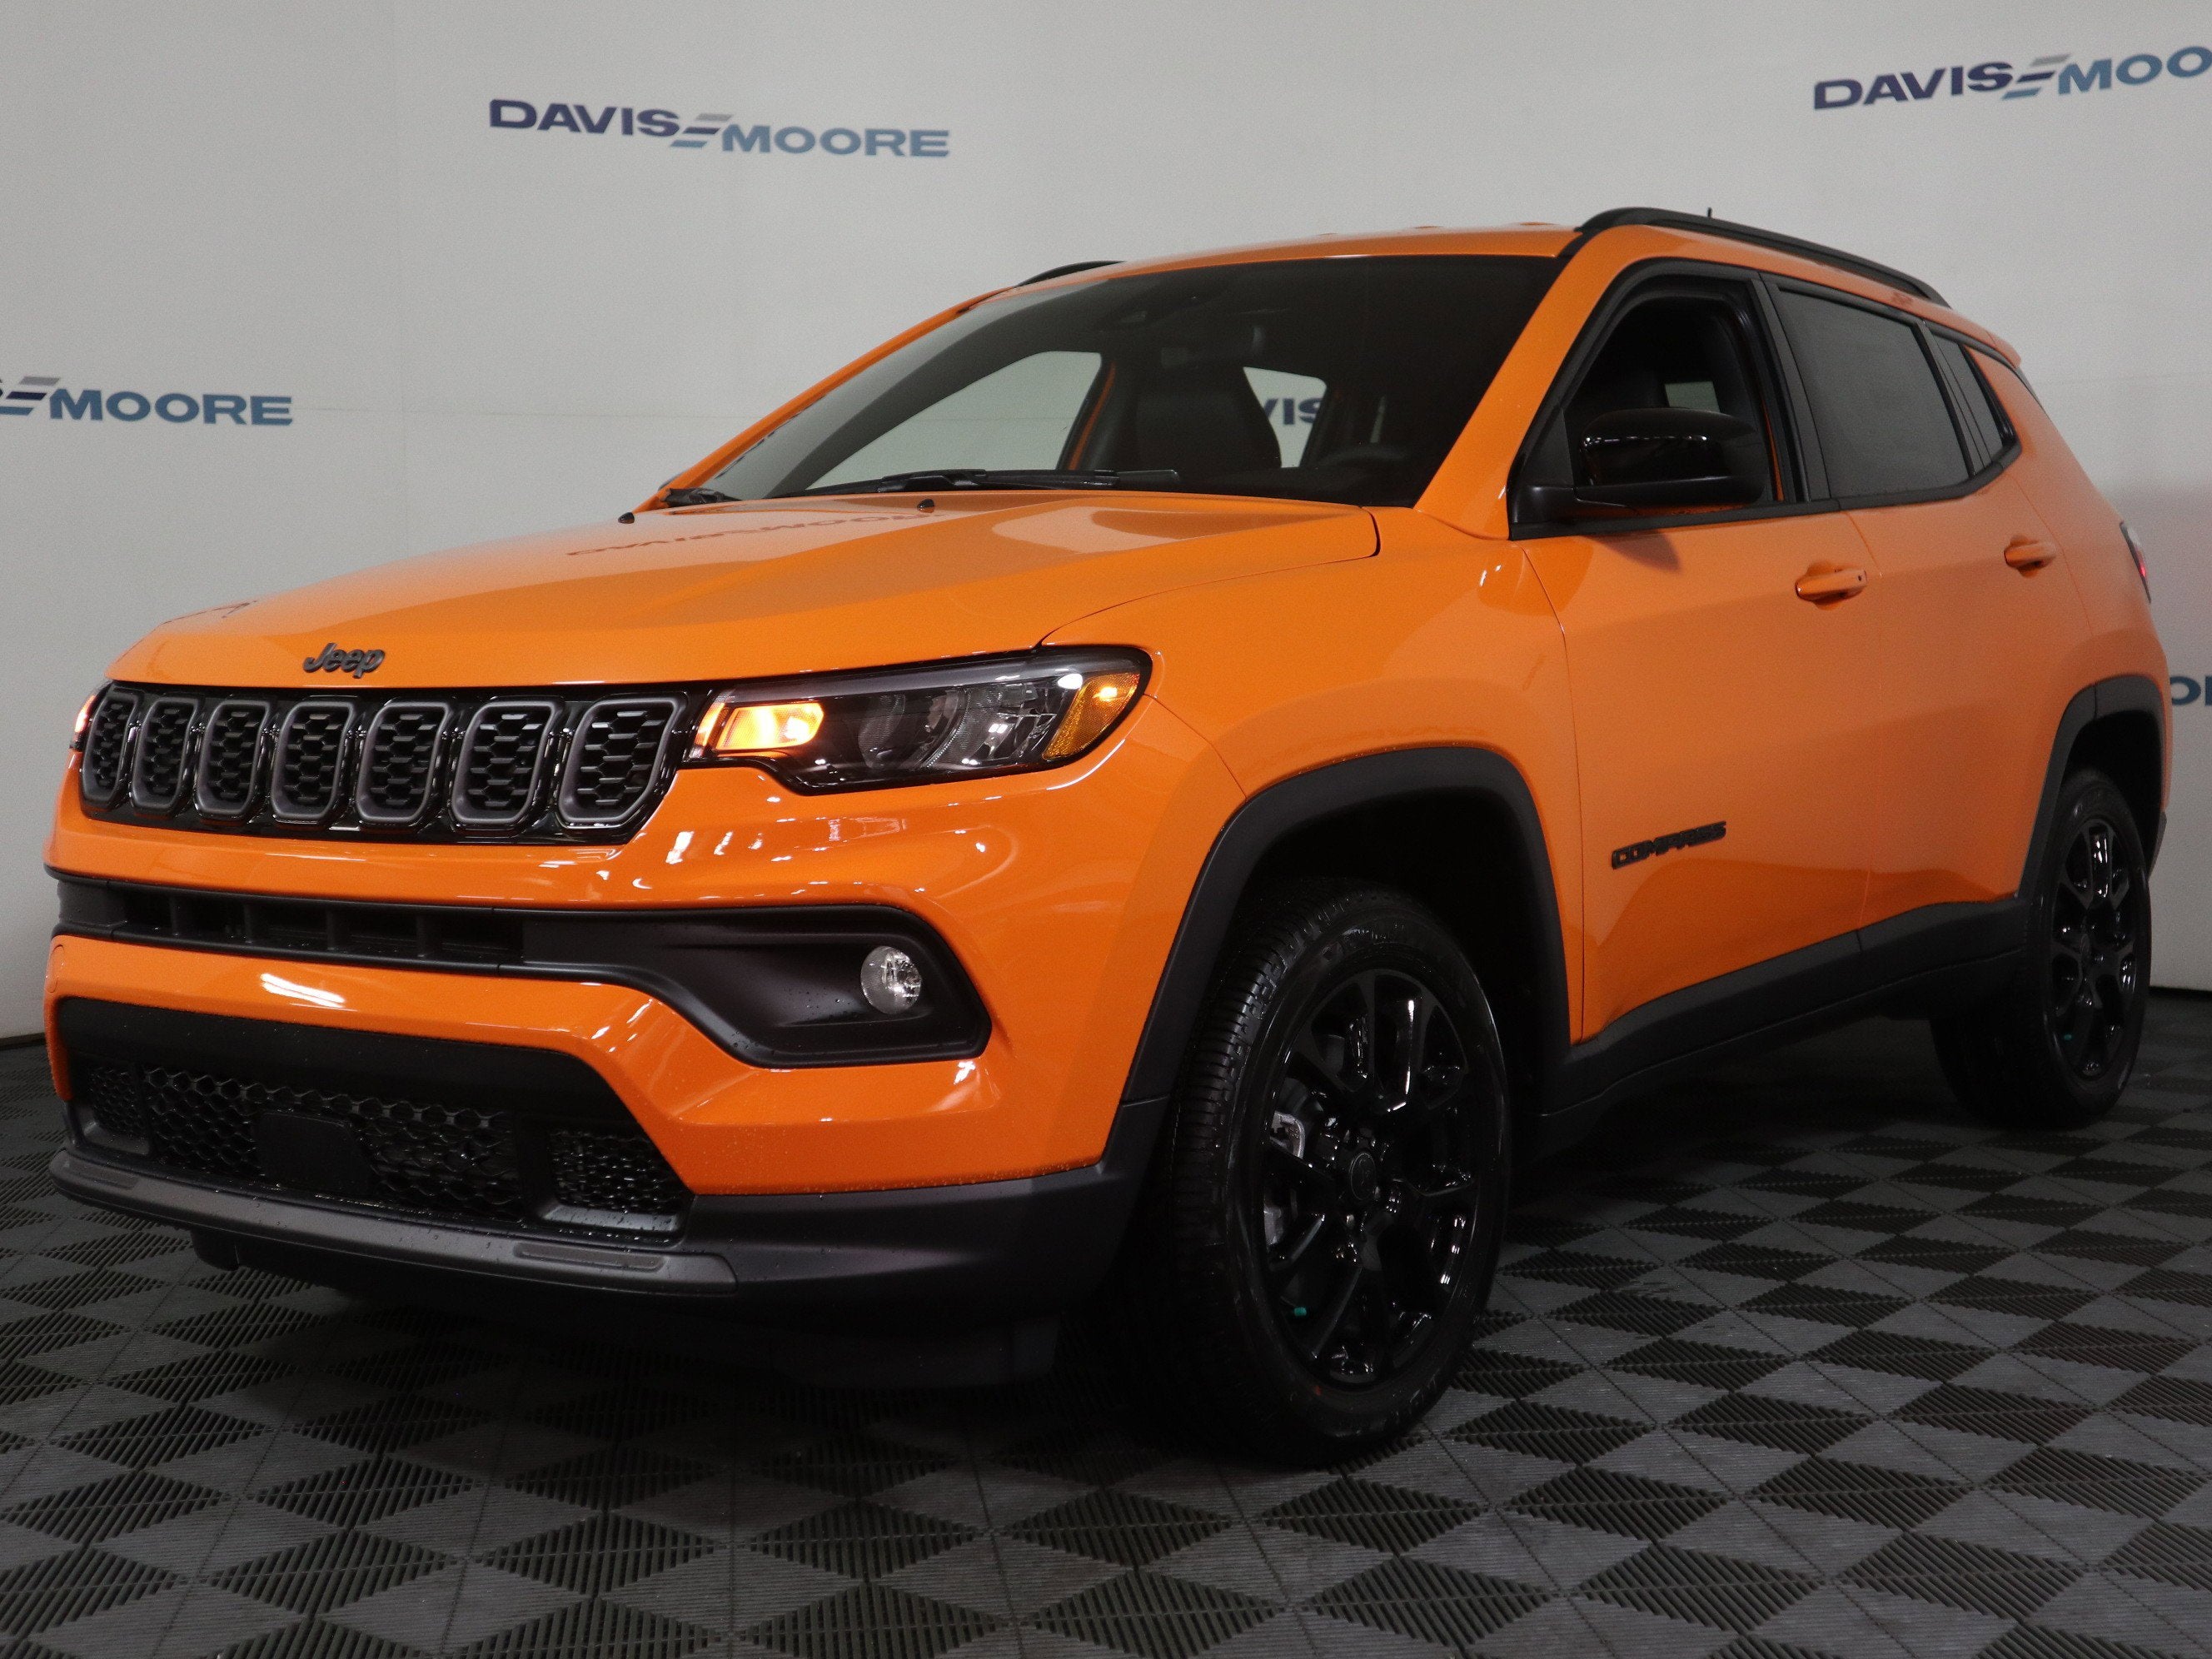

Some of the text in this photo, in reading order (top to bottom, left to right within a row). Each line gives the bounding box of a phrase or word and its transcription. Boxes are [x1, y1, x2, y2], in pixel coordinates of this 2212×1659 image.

[1814, 61, 2014, 109] DAVIS
[490, 99, 949, 157] DAVIS MOORE
[49, 388, 292, 426] MOORE
[302, 642, 386, 679] Jeep
